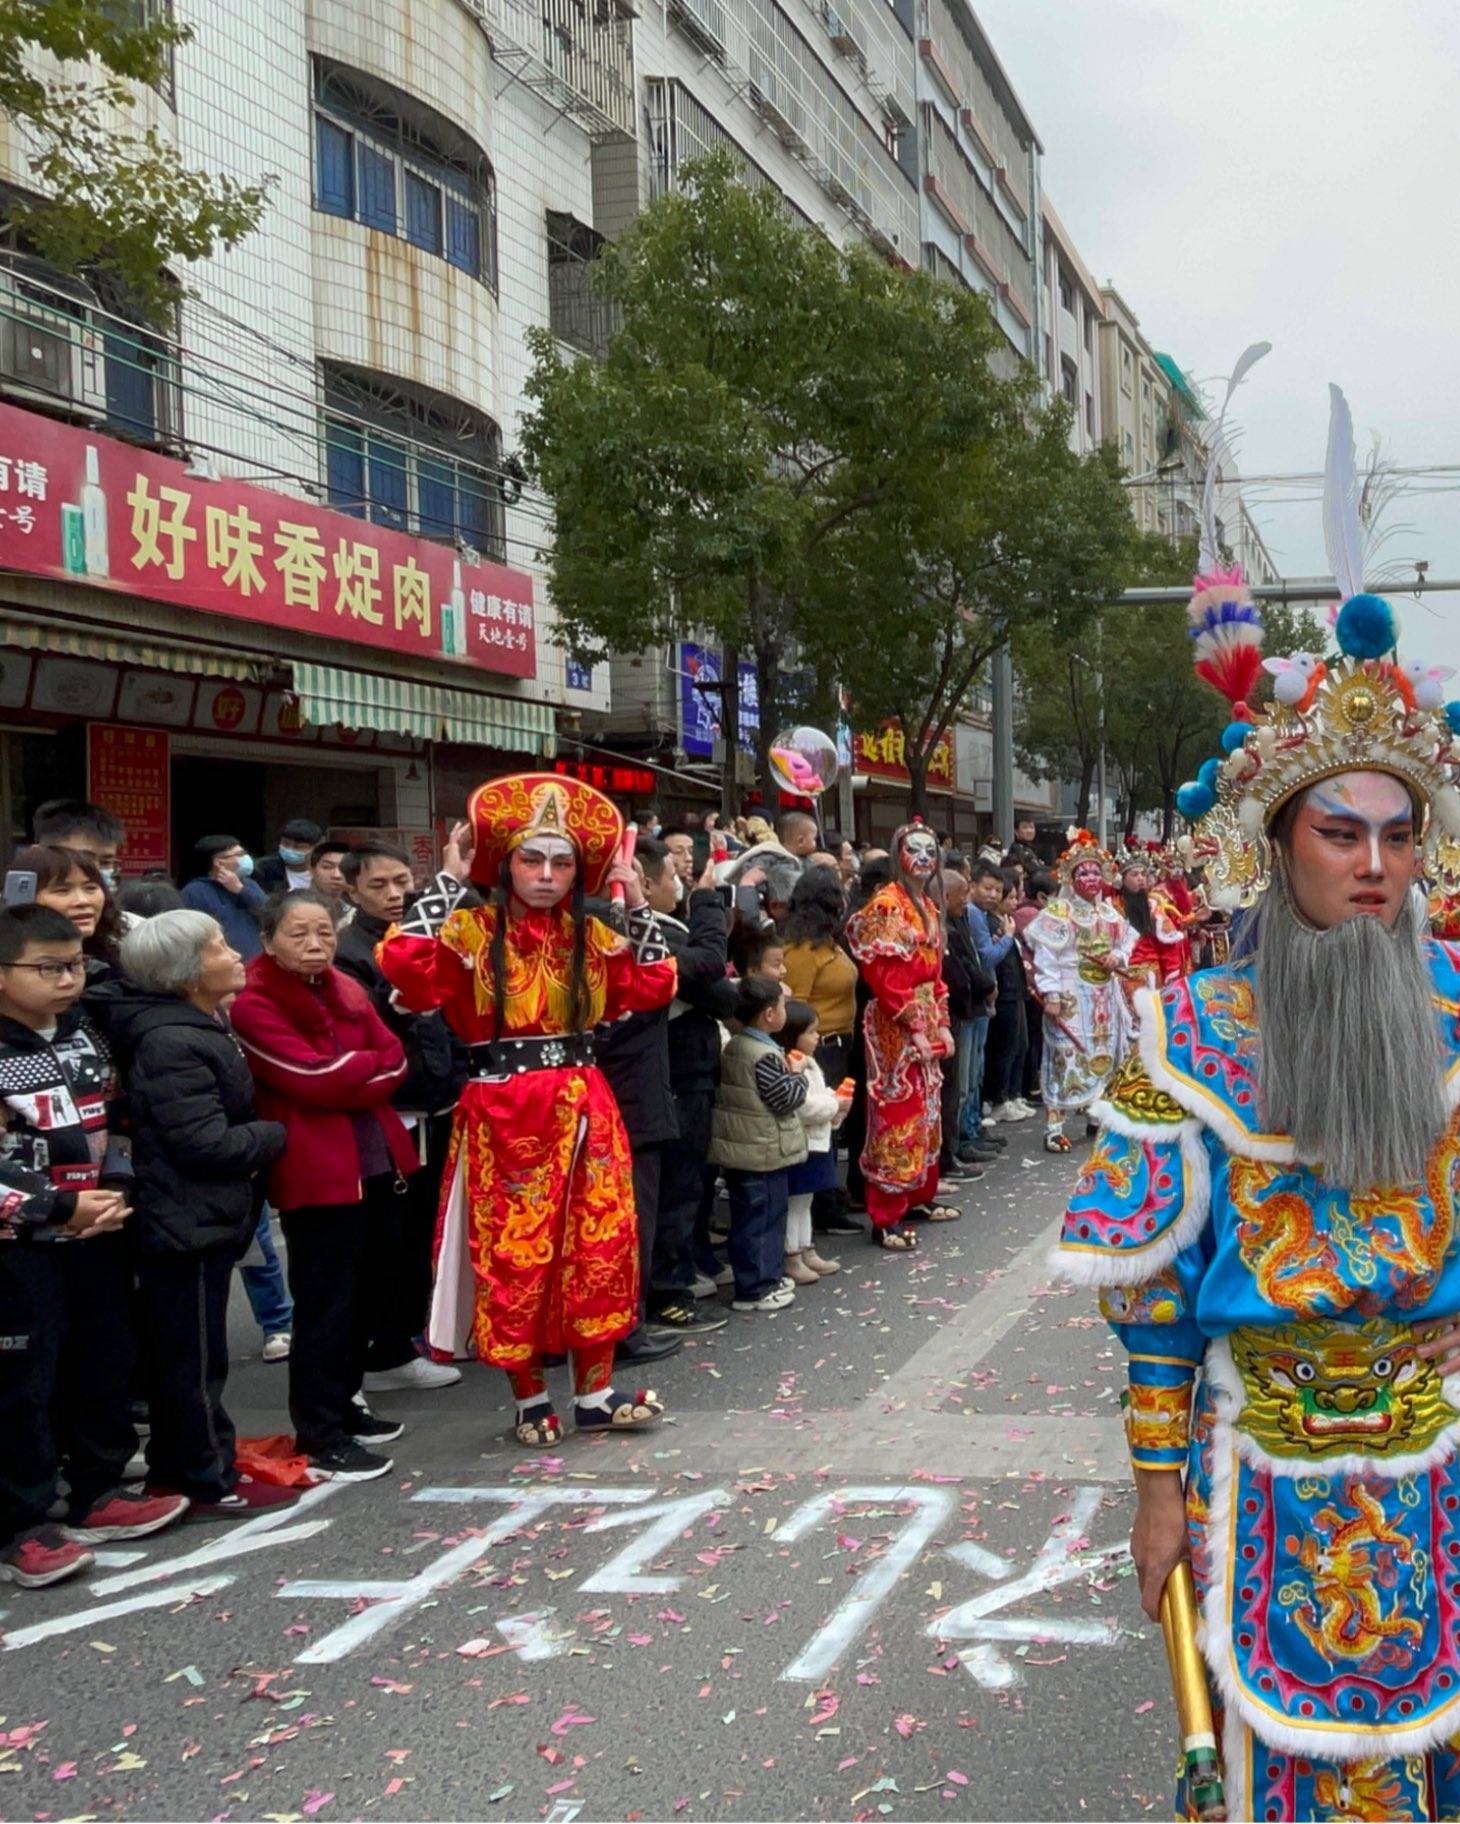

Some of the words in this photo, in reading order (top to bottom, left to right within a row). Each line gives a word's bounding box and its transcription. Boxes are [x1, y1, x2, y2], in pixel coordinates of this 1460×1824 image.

[0, 505, 36, 534] 号
[470, 588, 533, 630] 健康有请
[478, 622, 529, 652] 天地壹号
